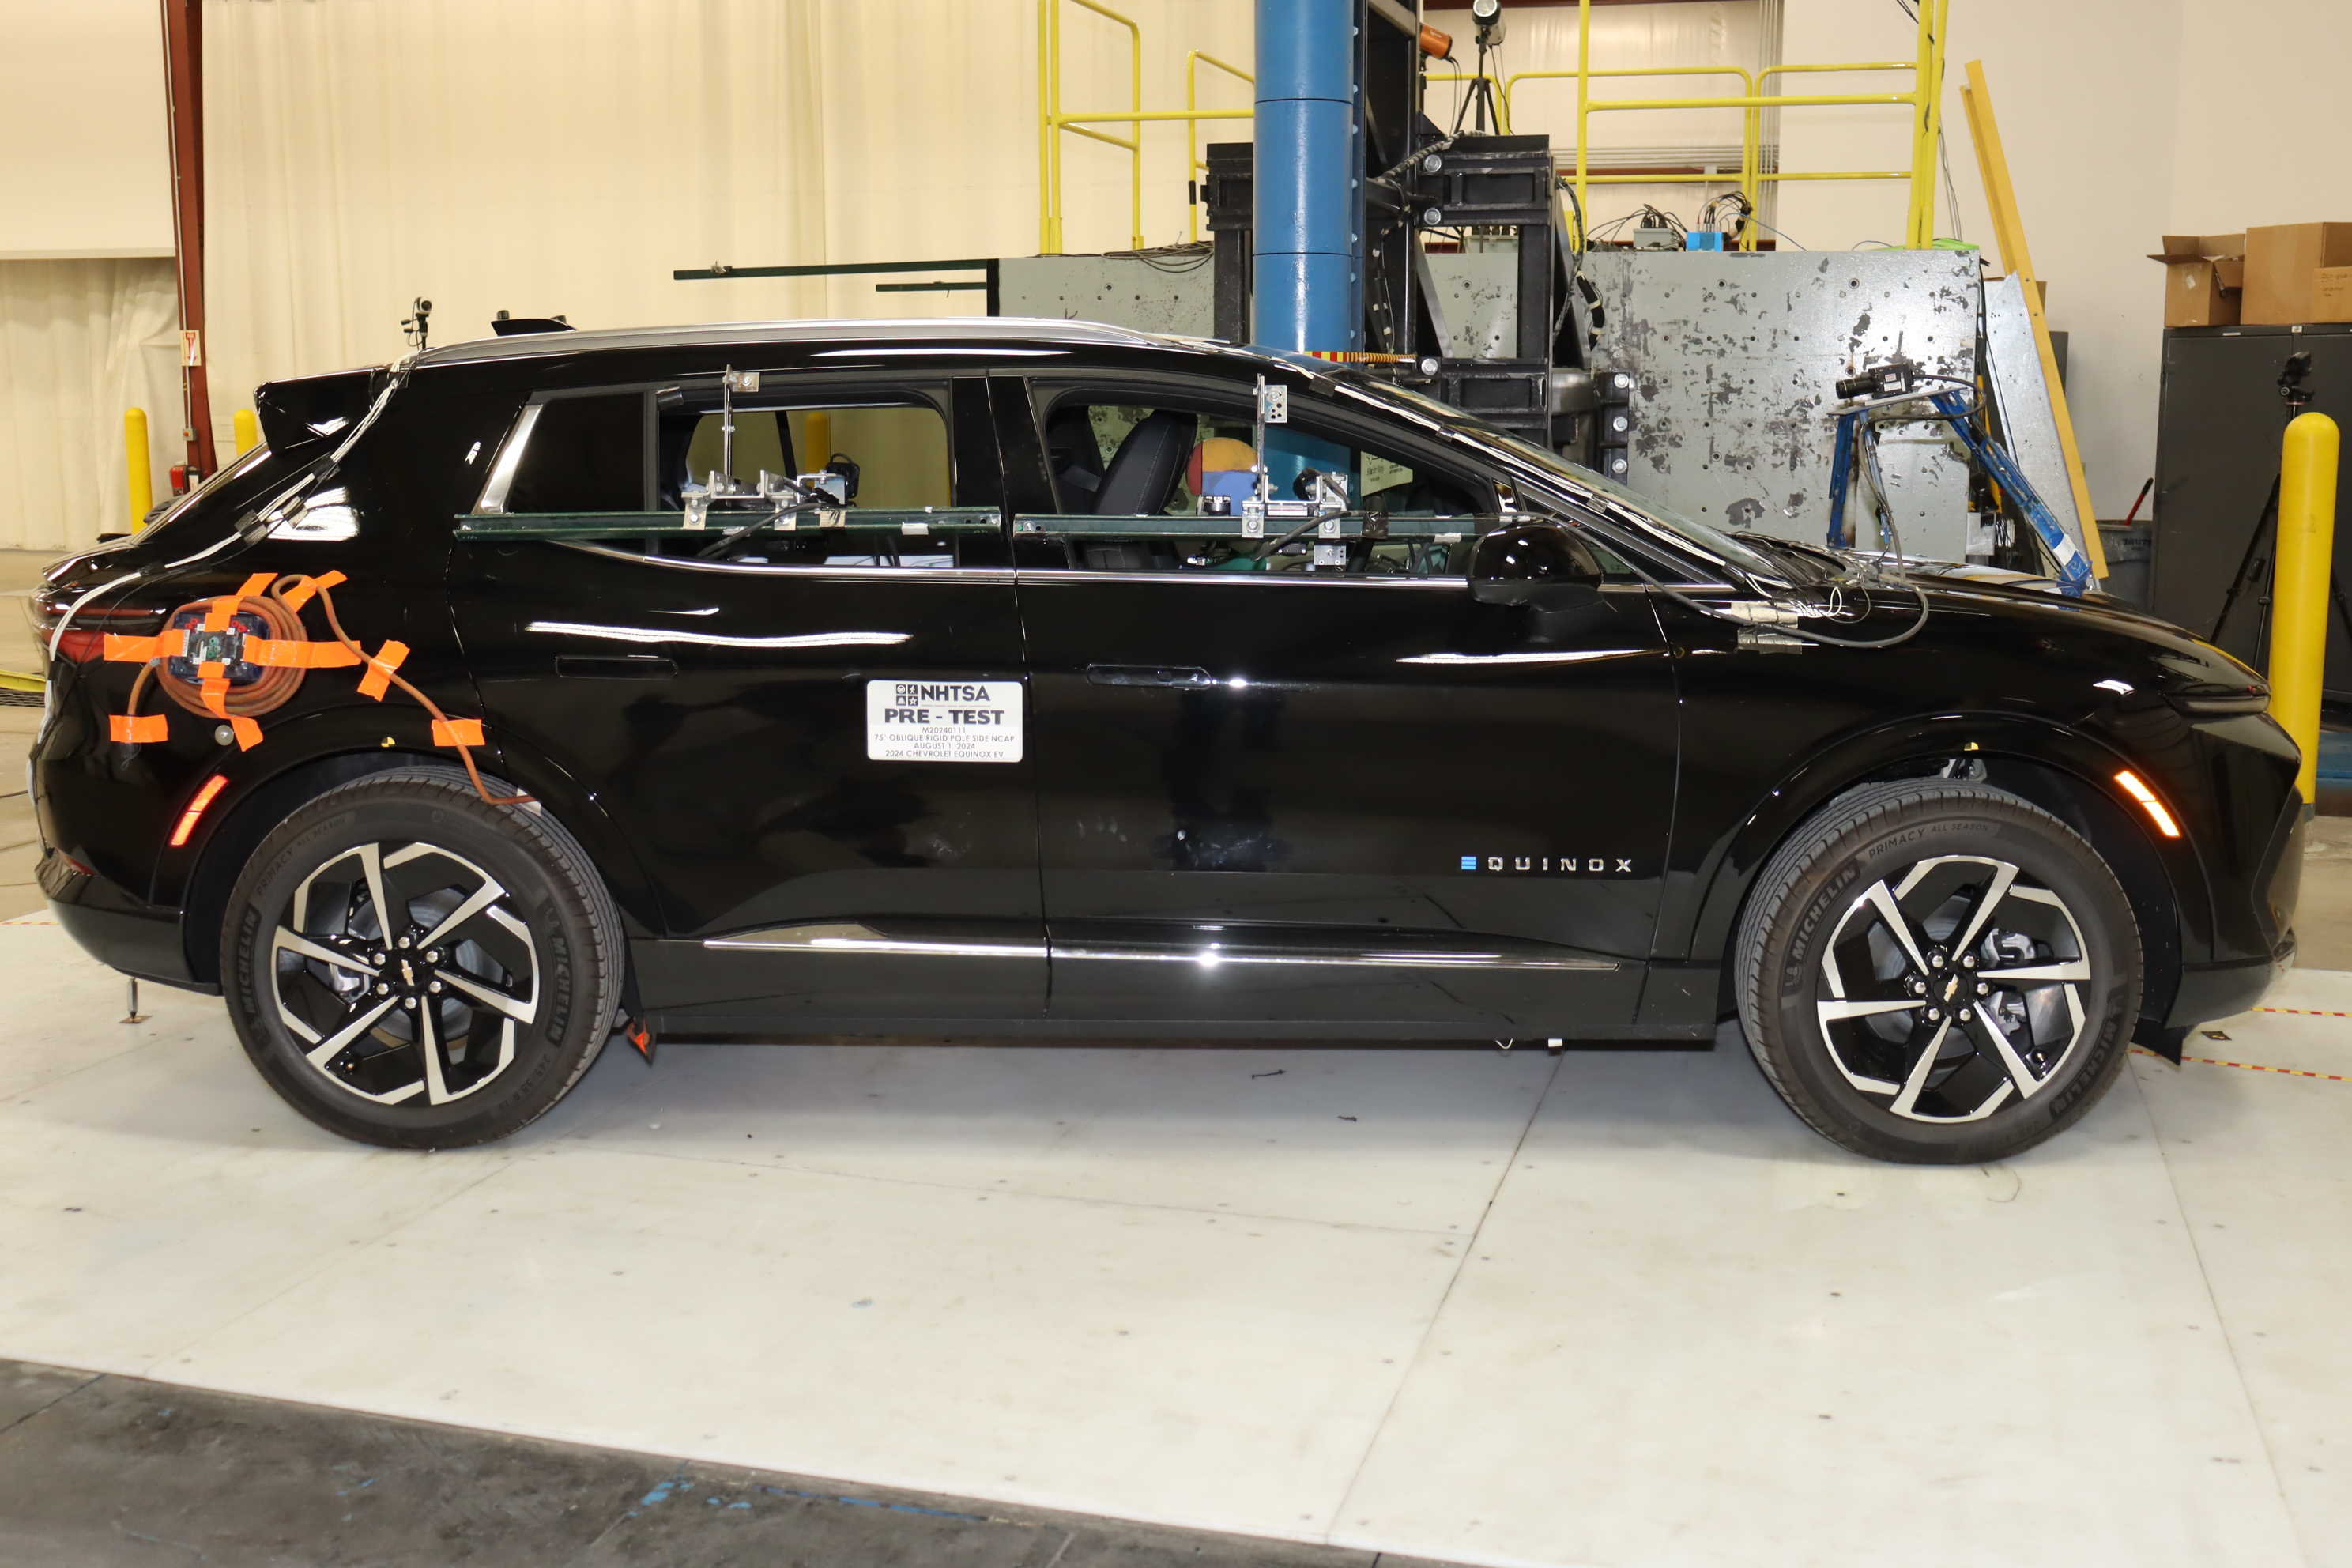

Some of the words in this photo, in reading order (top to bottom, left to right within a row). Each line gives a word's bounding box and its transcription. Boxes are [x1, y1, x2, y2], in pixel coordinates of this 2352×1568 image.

[884, 708, 930, 724] PRE
[948, 710, 1004, 725] TEST
[921, 684, 991, 702] NHTSA
[1461, 856, 1632, 872] EQUINOX
[1868, 827, 1925, 859] PRIMACY
[1931, 824, 1947, 833] ALL
[1952, 823, 1989, 831] SEASON
[1792, 865, 1856, 960] MICHELIN
[238, 910, 258, 1014] MICHELIN
[551, 937, 571, 1042] MICHELIN
[2052, 1020, 2117, 1114] MICHELIN
